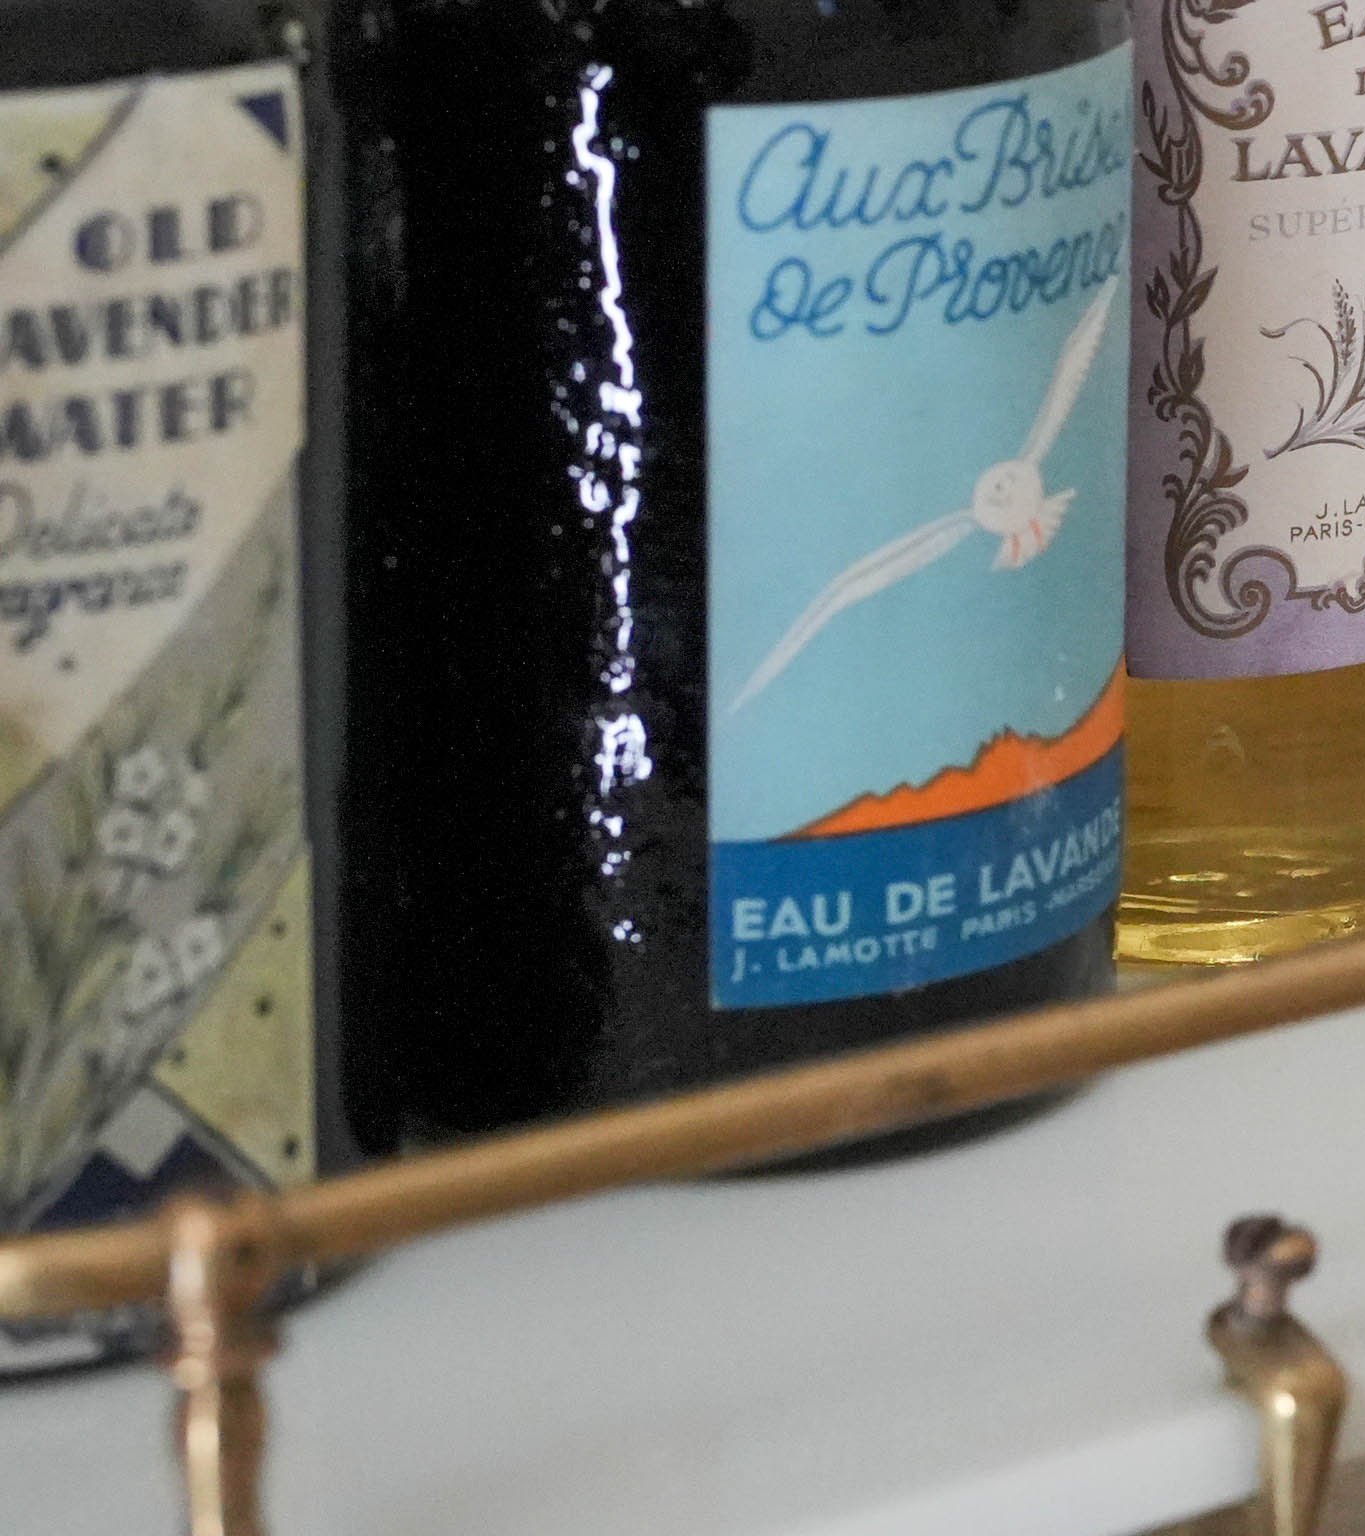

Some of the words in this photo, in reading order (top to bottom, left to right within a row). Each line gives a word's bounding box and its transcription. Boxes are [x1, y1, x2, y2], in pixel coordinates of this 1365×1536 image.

[738, 120, 953, 233] Aux
[73, 192, 264, 272] OLD
[731, 890, 852, 942] EAU
[886, 873, 957, 924] DE
[731, 948, 762, 983] J.
[776, 926, 939, 972] LAMOTTE
